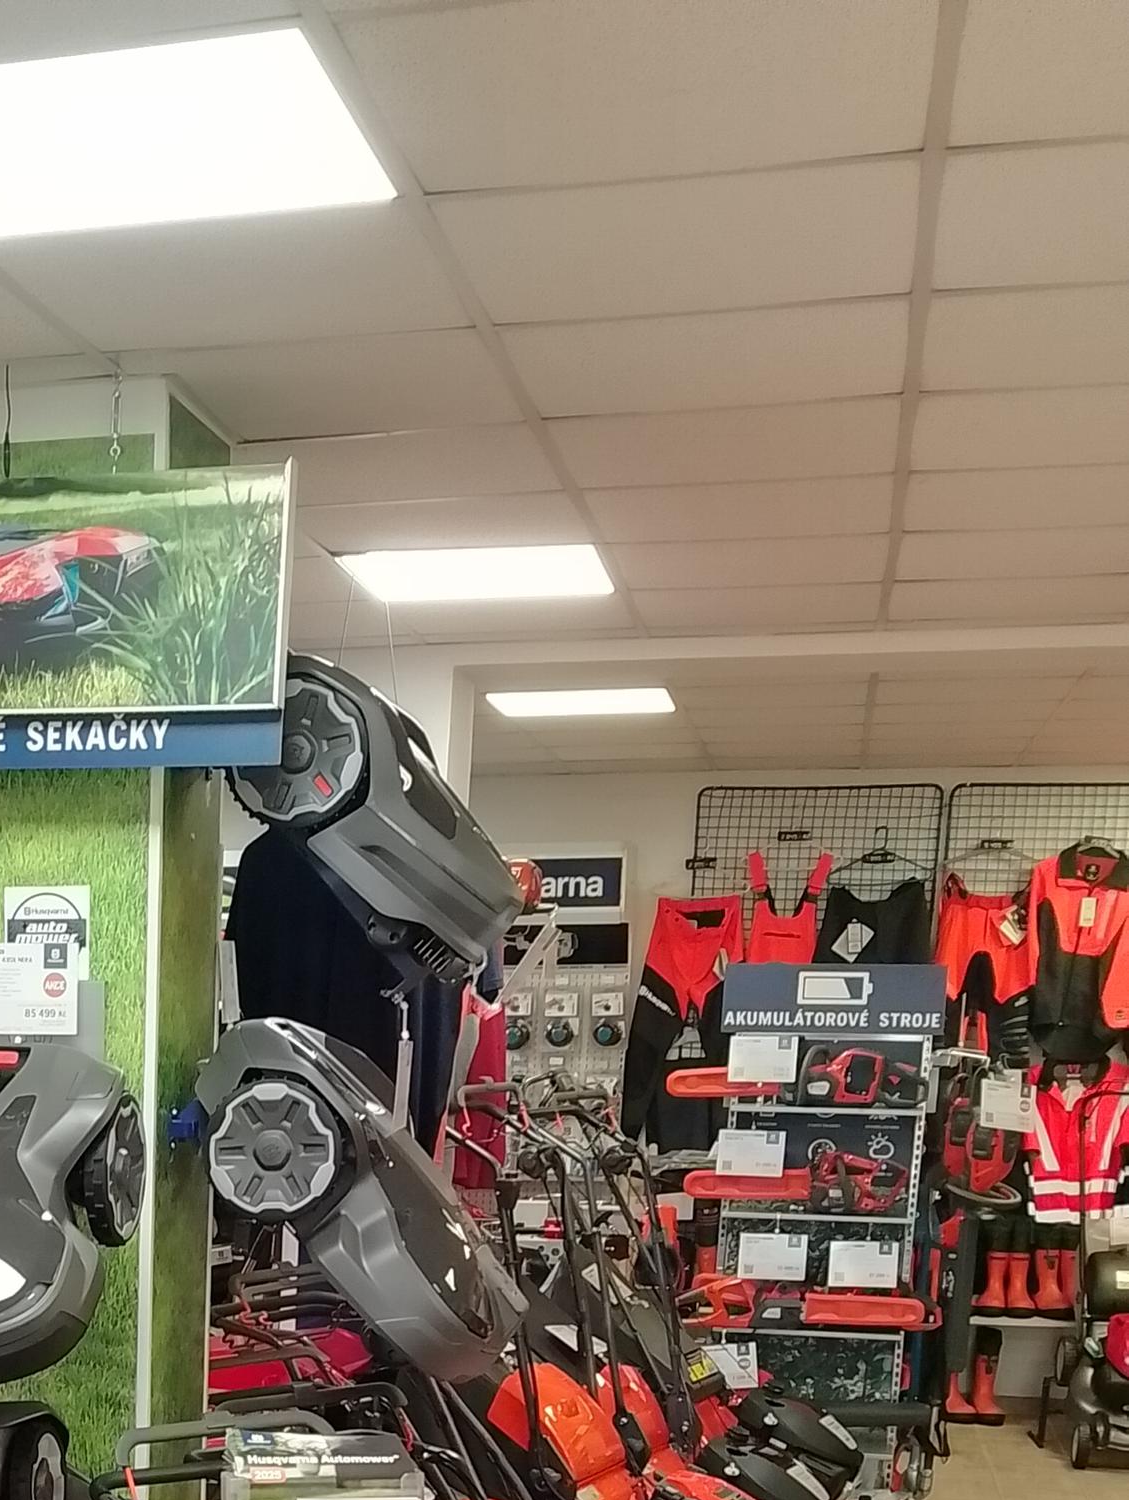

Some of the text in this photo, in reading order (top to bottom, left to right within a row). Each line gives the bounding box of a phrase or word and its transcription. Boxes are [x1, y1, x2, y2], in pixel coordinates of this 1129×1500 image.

[25, 713, 170, 751] SEKAČKY
[25, 921, 68, 933] auto
[15, 933, 79, 944] mower
[24, 1008, 37, 1018] 85
[723, 1008, 941, 1029] AKUMULÁTOROVÉ STROJE
[247, 1454, 319, 1467] Husqvarna
